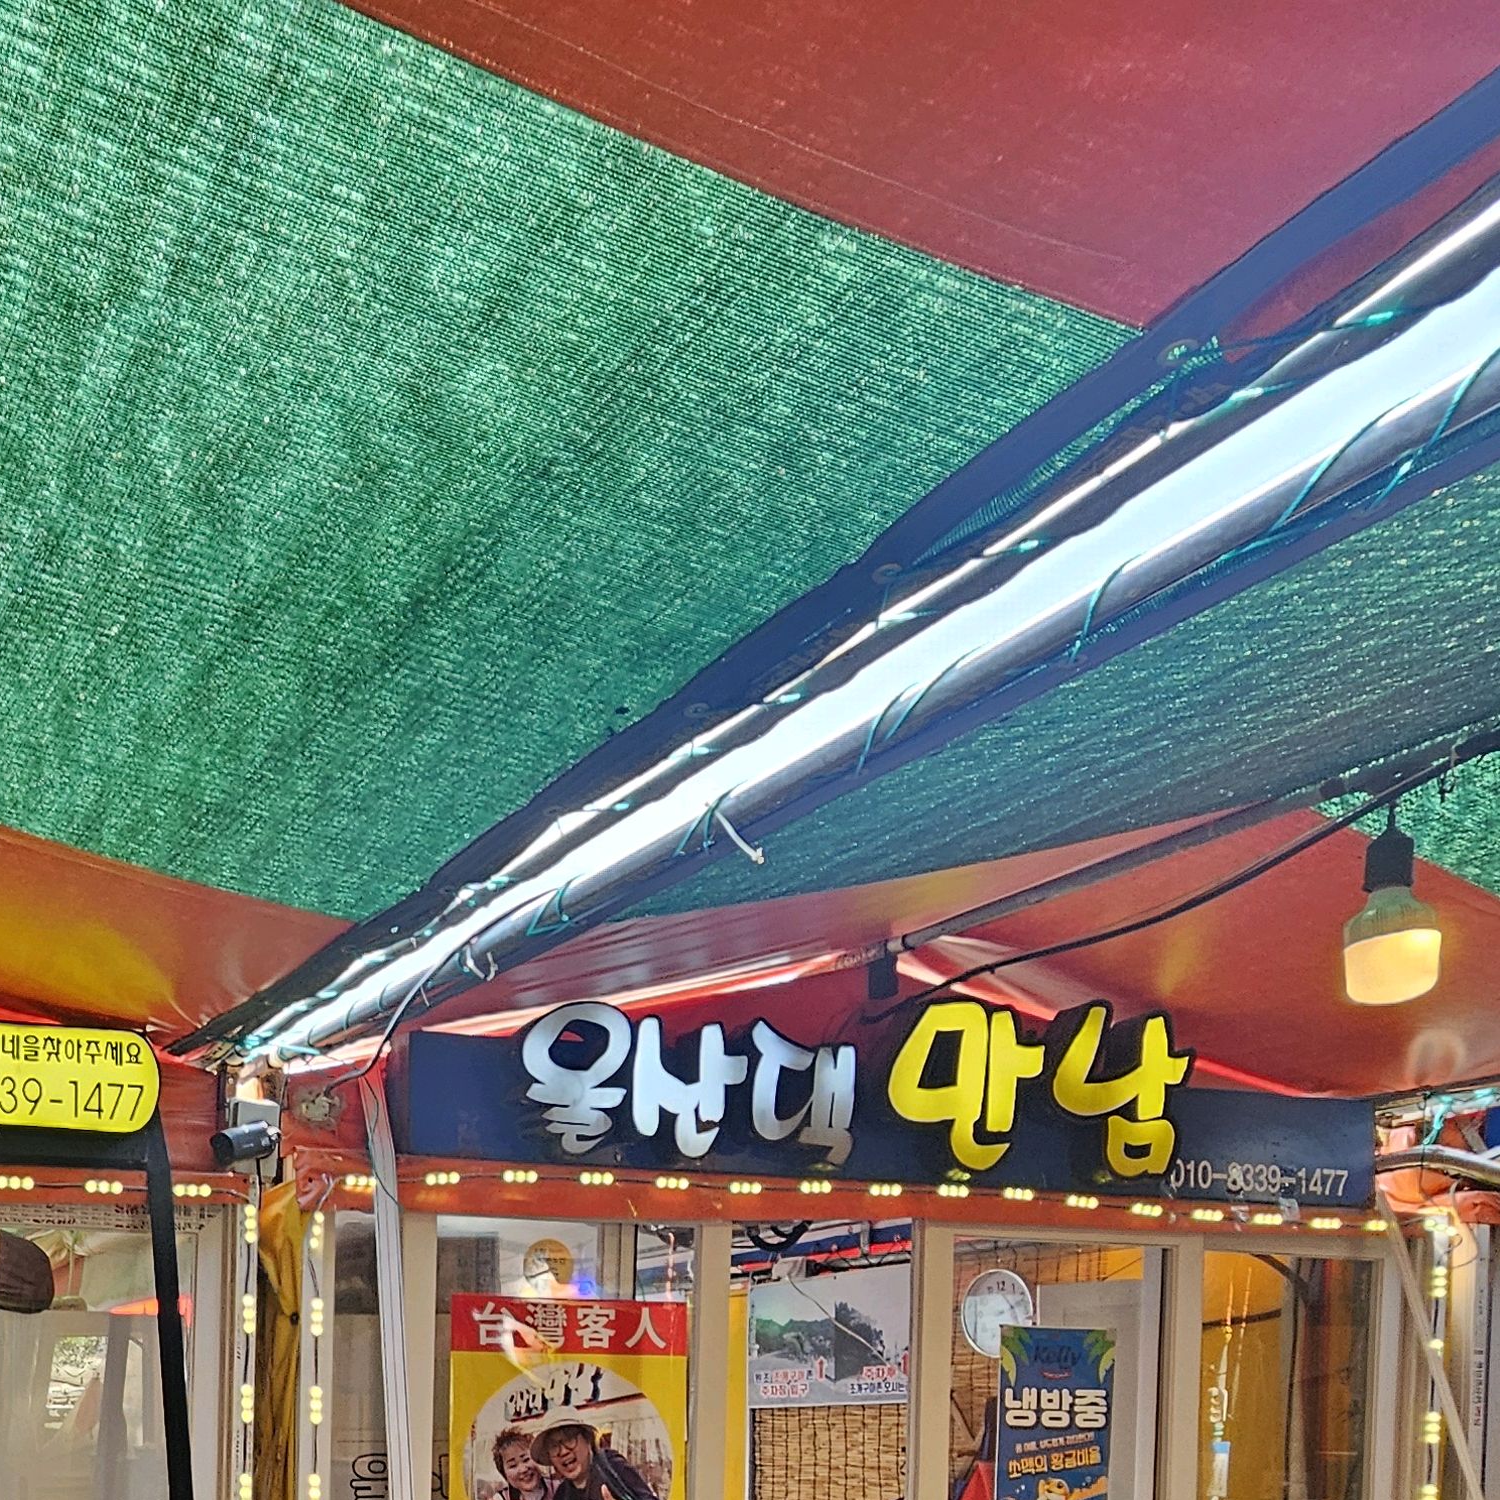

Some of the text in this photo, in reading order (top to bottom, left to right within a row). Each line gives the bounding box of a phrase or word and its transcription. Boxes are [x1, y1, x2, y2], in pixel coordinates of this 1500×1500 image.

[522, 1001, 1190, 1174] 울산댁 만남
[1173, 1158, 1349, 1197] 010-8339-1477
[474, 1301, 667, 1350] 台灣客人
[1005, 1387, 1107, 1428] 냉방중
